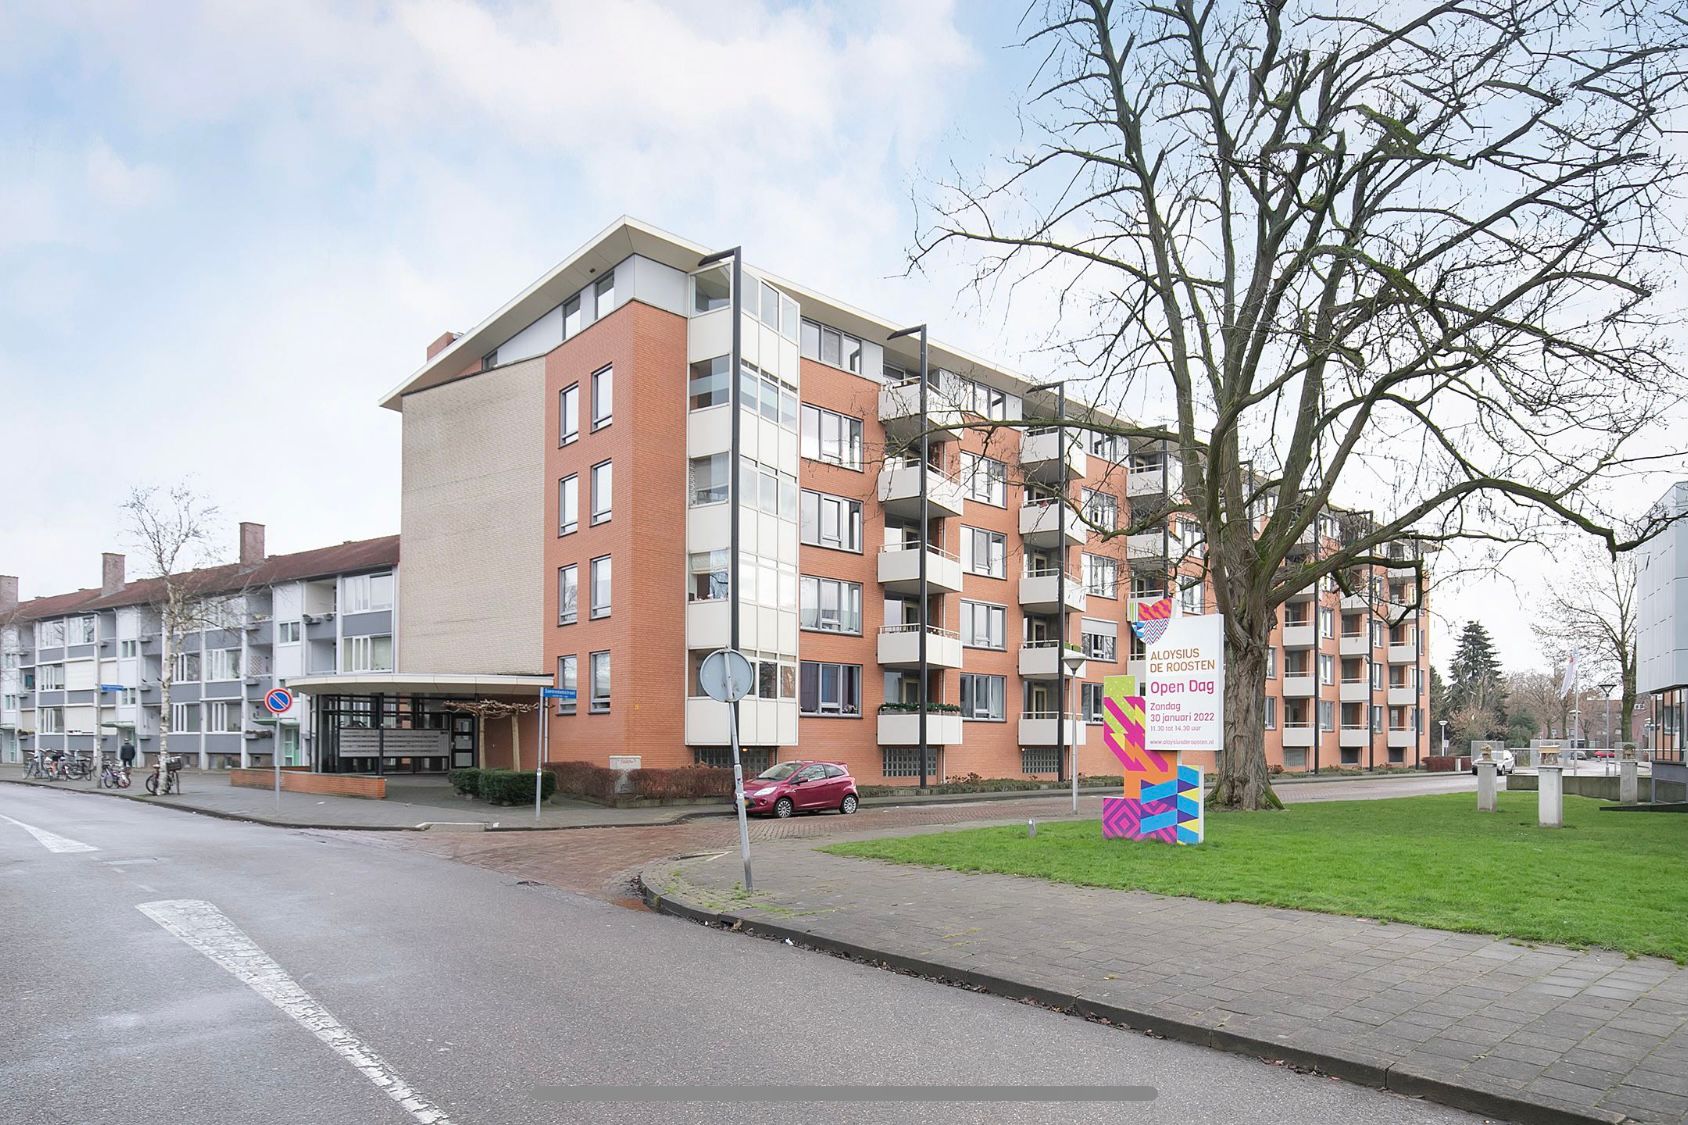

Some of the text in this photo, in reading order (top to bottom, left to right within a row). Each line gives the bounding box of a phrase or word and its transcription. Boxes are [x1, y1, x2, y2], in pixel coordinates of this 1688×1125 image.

[1150, 648, 1200, 660] ALOYSIUS
[1150, 660, 1215, 672] DE ROOSTEN
[1150, 680, 1214, 696] Open Dag
[1150, 701, 1181, 712] Zondag
[1150, 712, 1214, 724] 30 januari 2022
